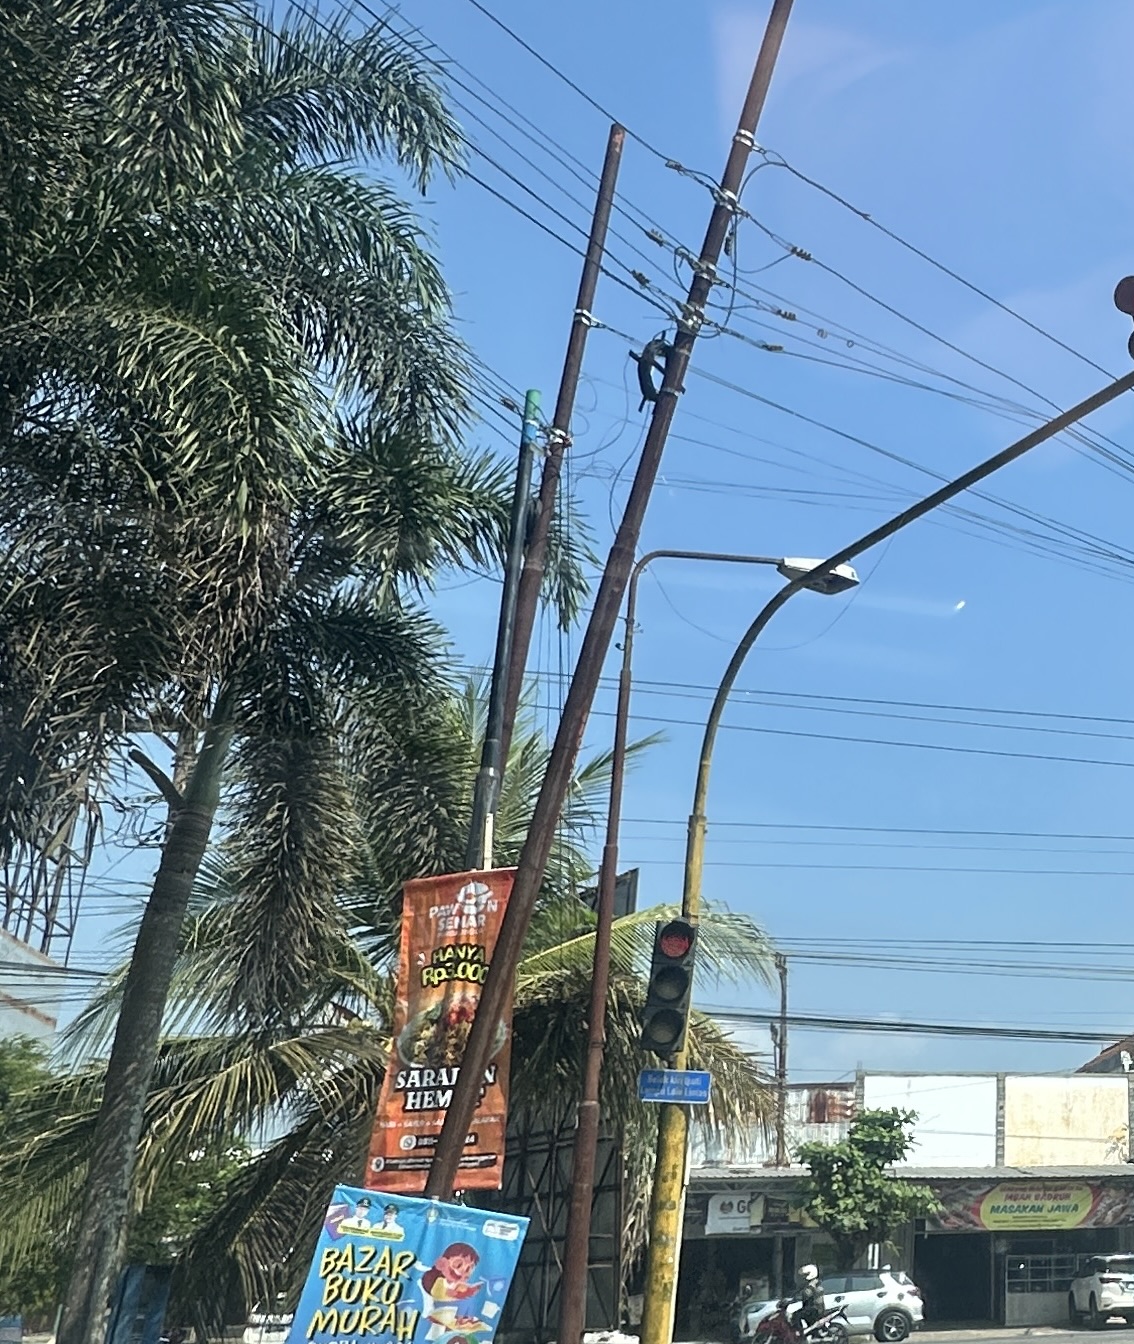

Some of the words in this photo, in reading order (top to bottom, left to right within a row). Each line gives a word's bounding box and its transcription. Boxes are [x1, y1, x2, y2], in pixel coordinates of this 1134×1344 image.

[433, 946, 485, 964] HANYA
[395, 1064, 496, 1089] SARAN
[990, 1204, 1044, 1214] MASAKAN
[1047, 1203, 1079, 1213] JAWA
[321, 1243, 415, 1279] BAZAR
[324, 1273, 401, 1305] BUKU
[306, 1304, 419, 1341] MURAH
